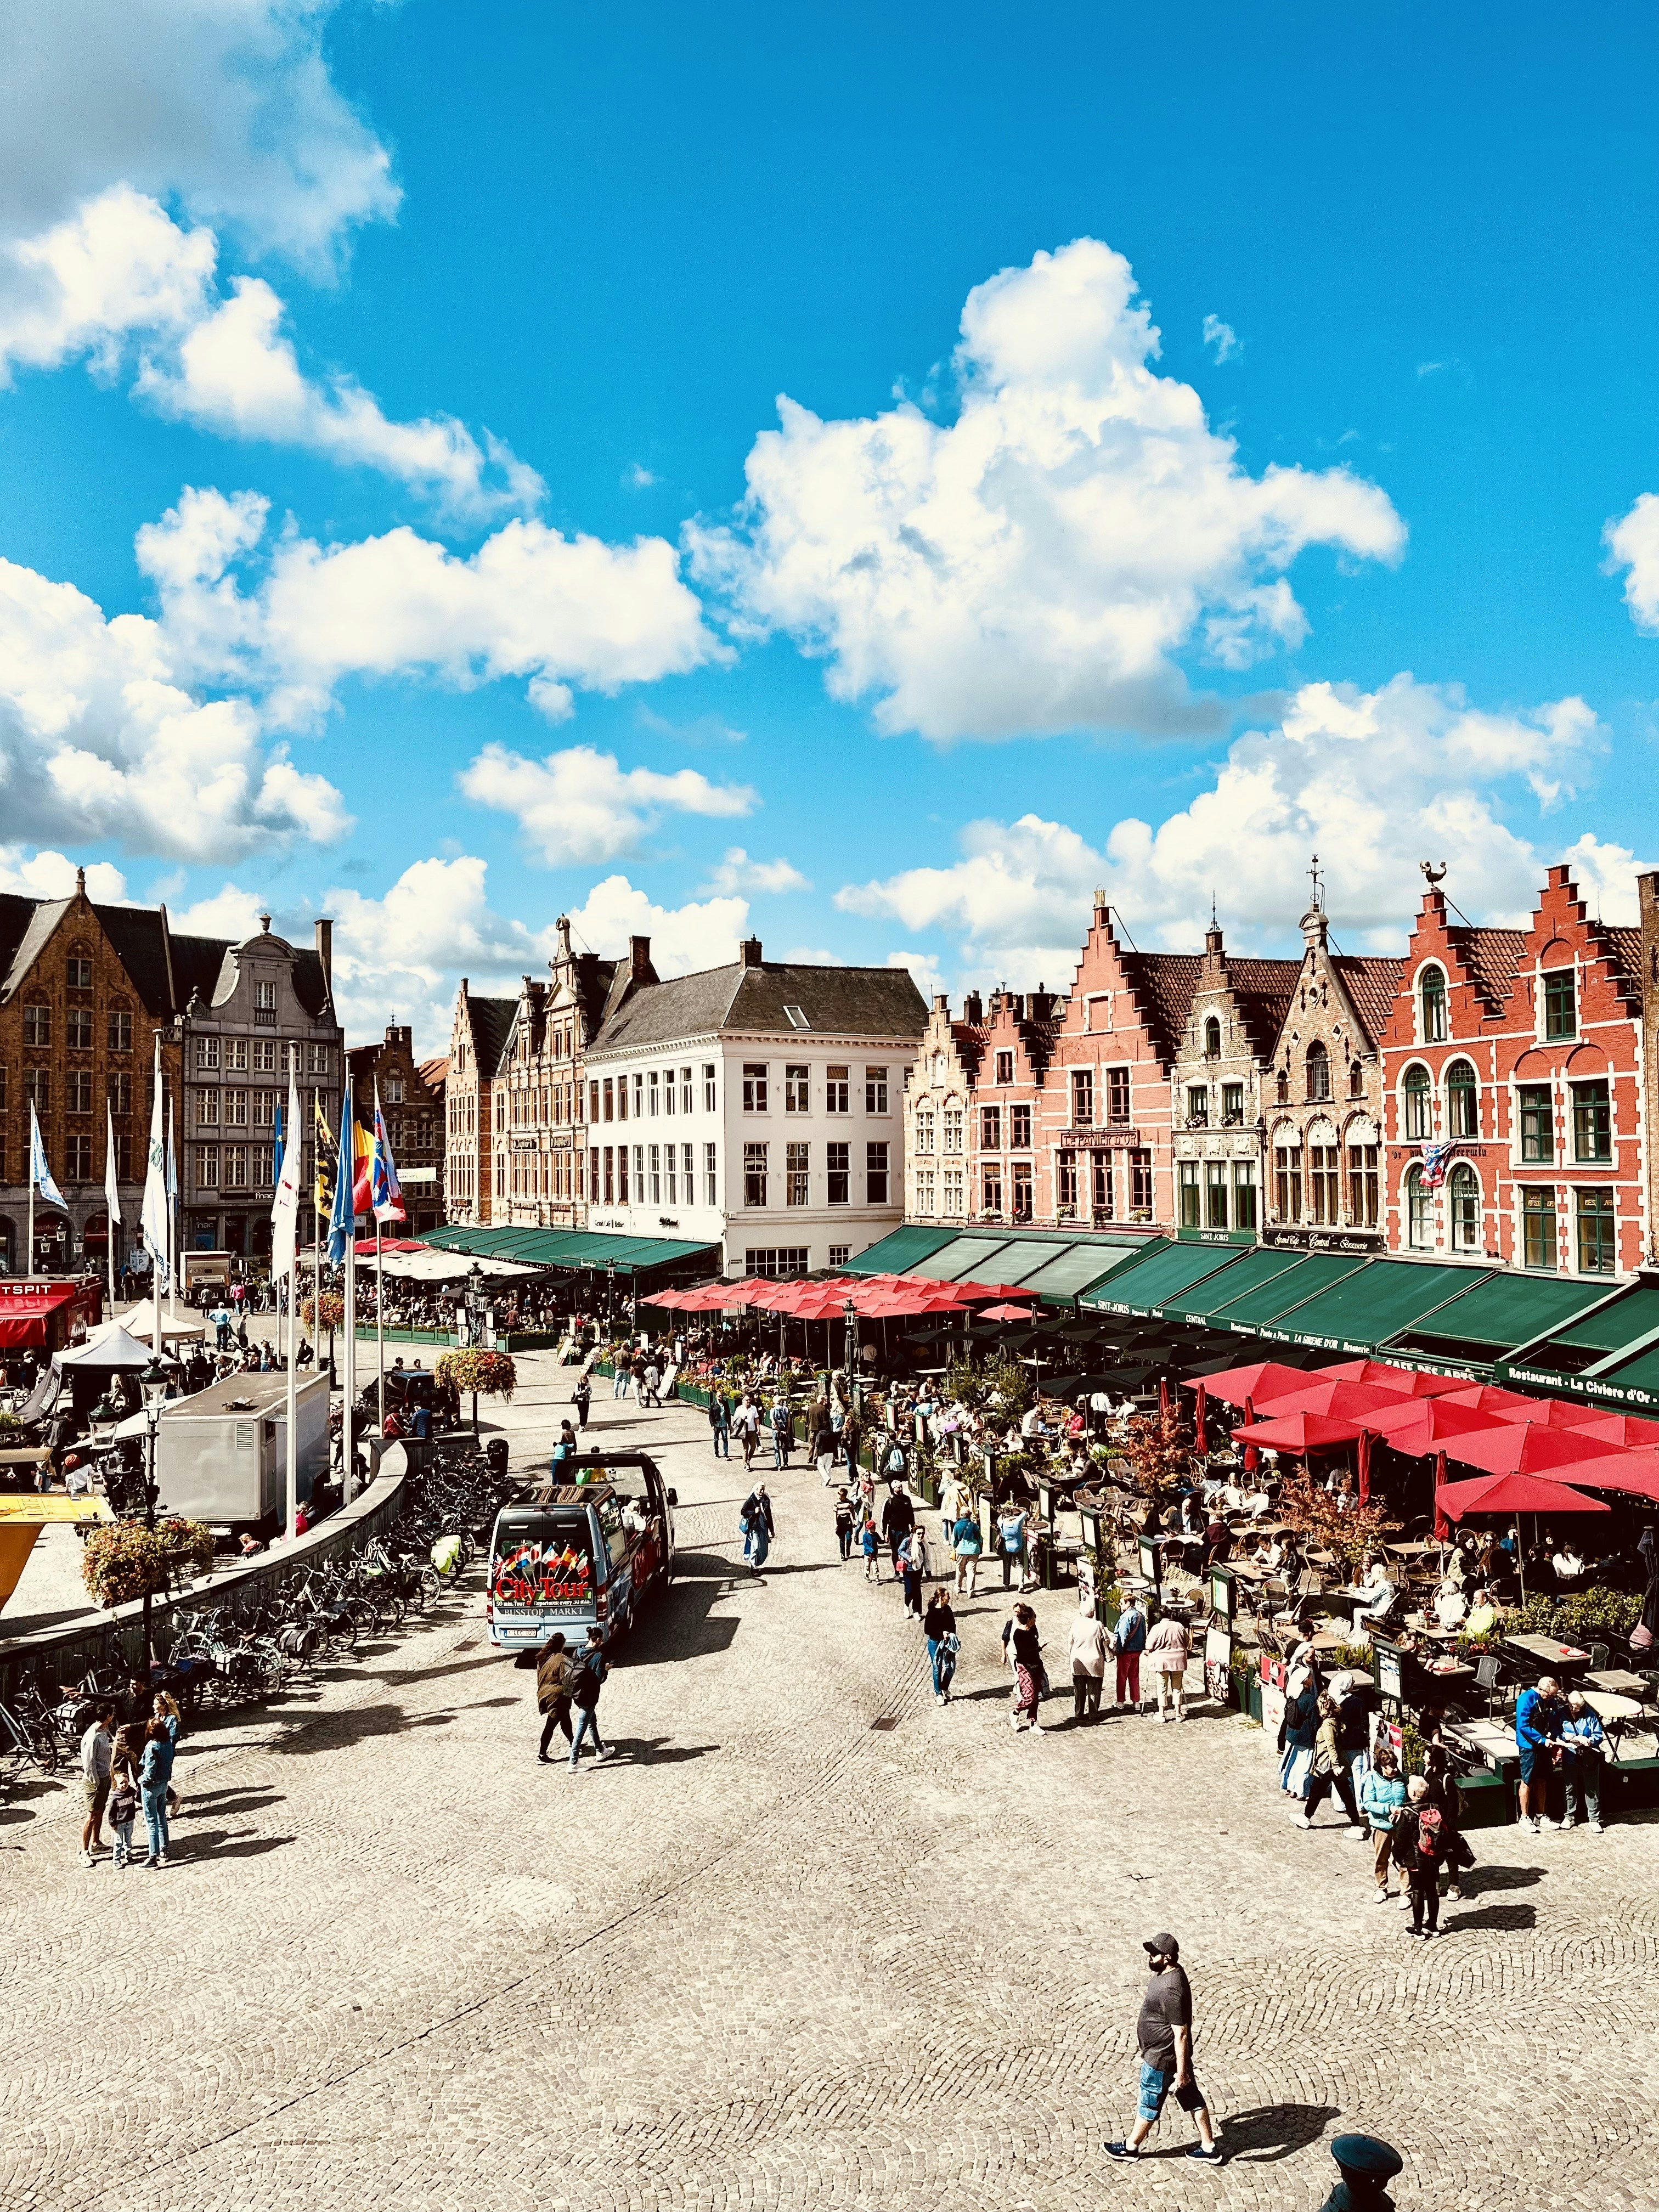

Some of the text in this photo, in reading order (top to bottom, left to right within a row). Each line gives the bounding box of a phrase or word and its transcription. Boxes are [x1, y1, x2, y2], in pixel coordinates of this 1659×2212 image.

[1065, 1136, 1076, 1147] LE
[1078, 1135, 1111, 1147] PANIER
[255, 1192, 274, 1200] fnac
[1200, 1232, 1229, 1241] SINT JORIS
[1309, 1233, 1330, 1248] Central
[1340, 1237, 1368, 1250] Brasserie
[1097, 1300, 1130, 1314] SINT-JORIS
[1186, 1314, 1207, 1325] CENTRAL
[1294, 1334, 1302, 1343] LA
[1302, 1335, 1324, 1347] SIRENE
[1342, 1341, 1370, 1354] Brasserie
[1509, 1367, 1650, 1403] Restaurant La Civiere d'Or
[496, 1577, 588, 1605] City Tour
[550, 1607, 584, 1616] MARKT
